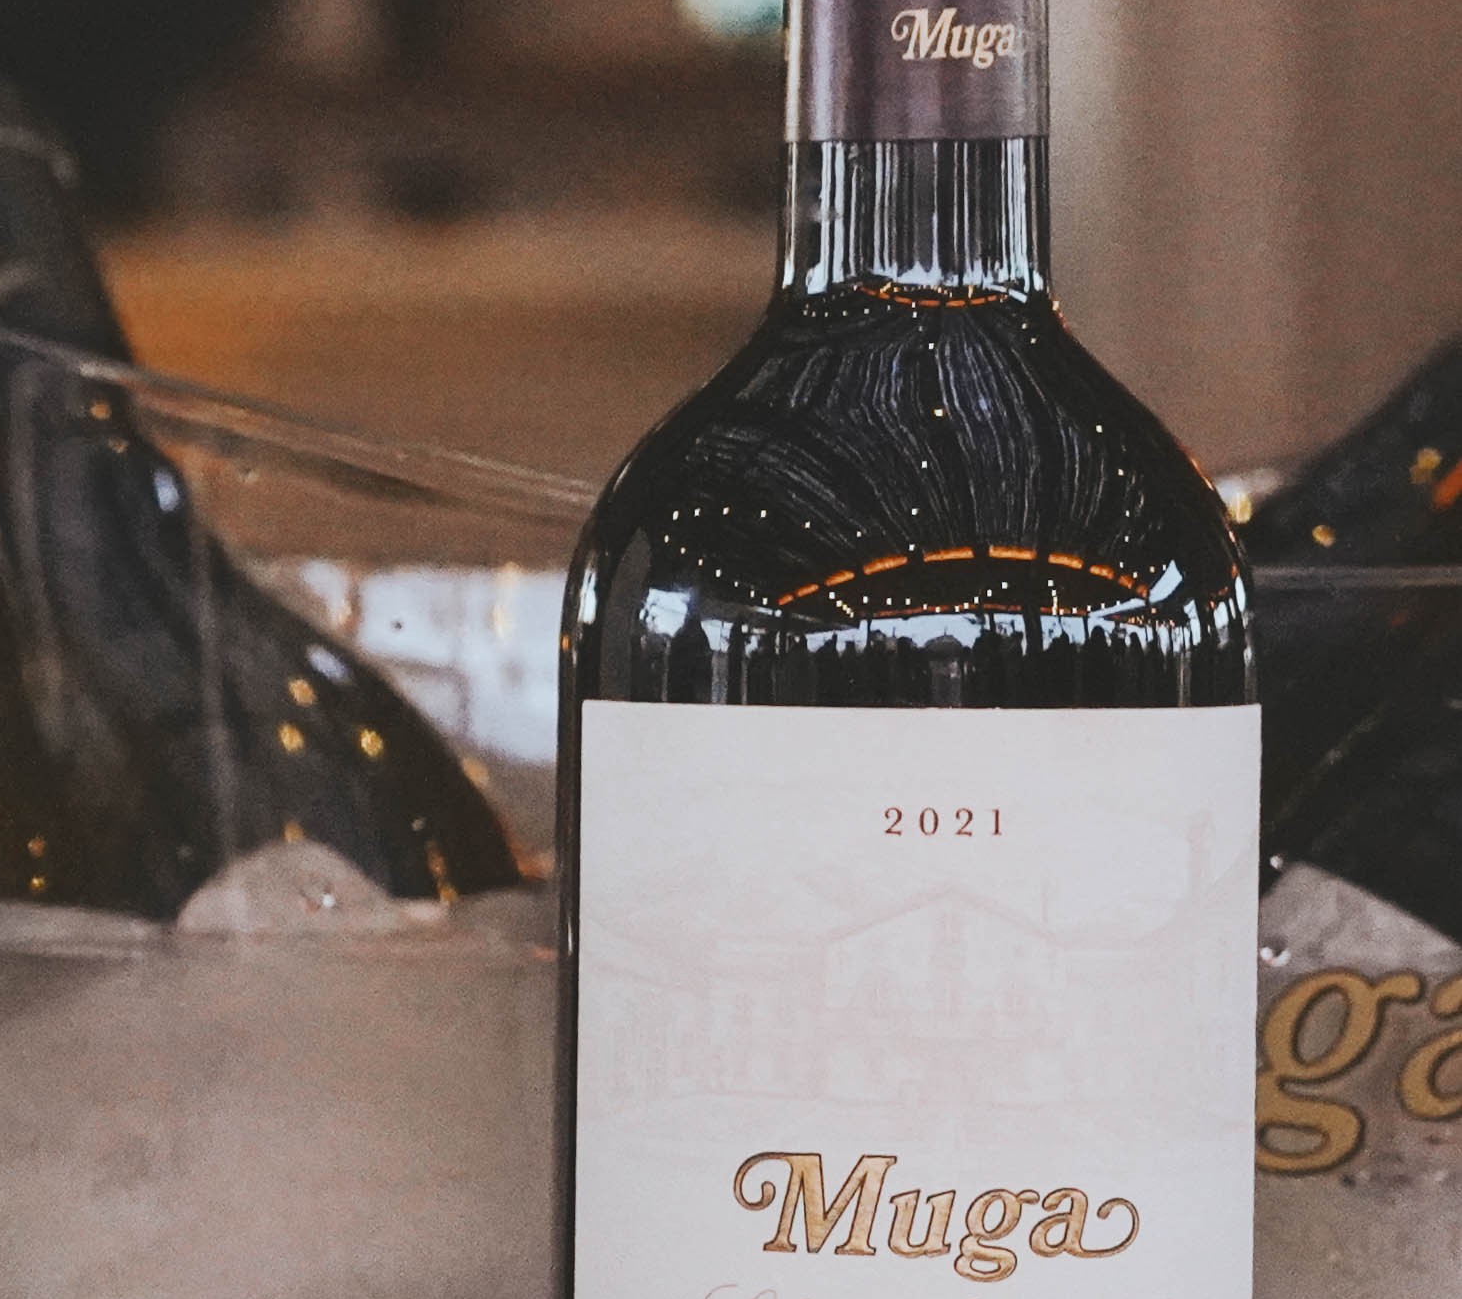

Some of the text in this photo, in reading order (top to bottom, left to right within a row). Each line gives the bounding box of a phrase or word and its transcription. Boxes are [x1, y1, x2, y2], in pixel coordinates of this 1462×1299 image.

[891, 7, 1024, 70] Muga
[884, 806, 1005, 839] 2021
[733, 1150, 1140, 1283] Muga
